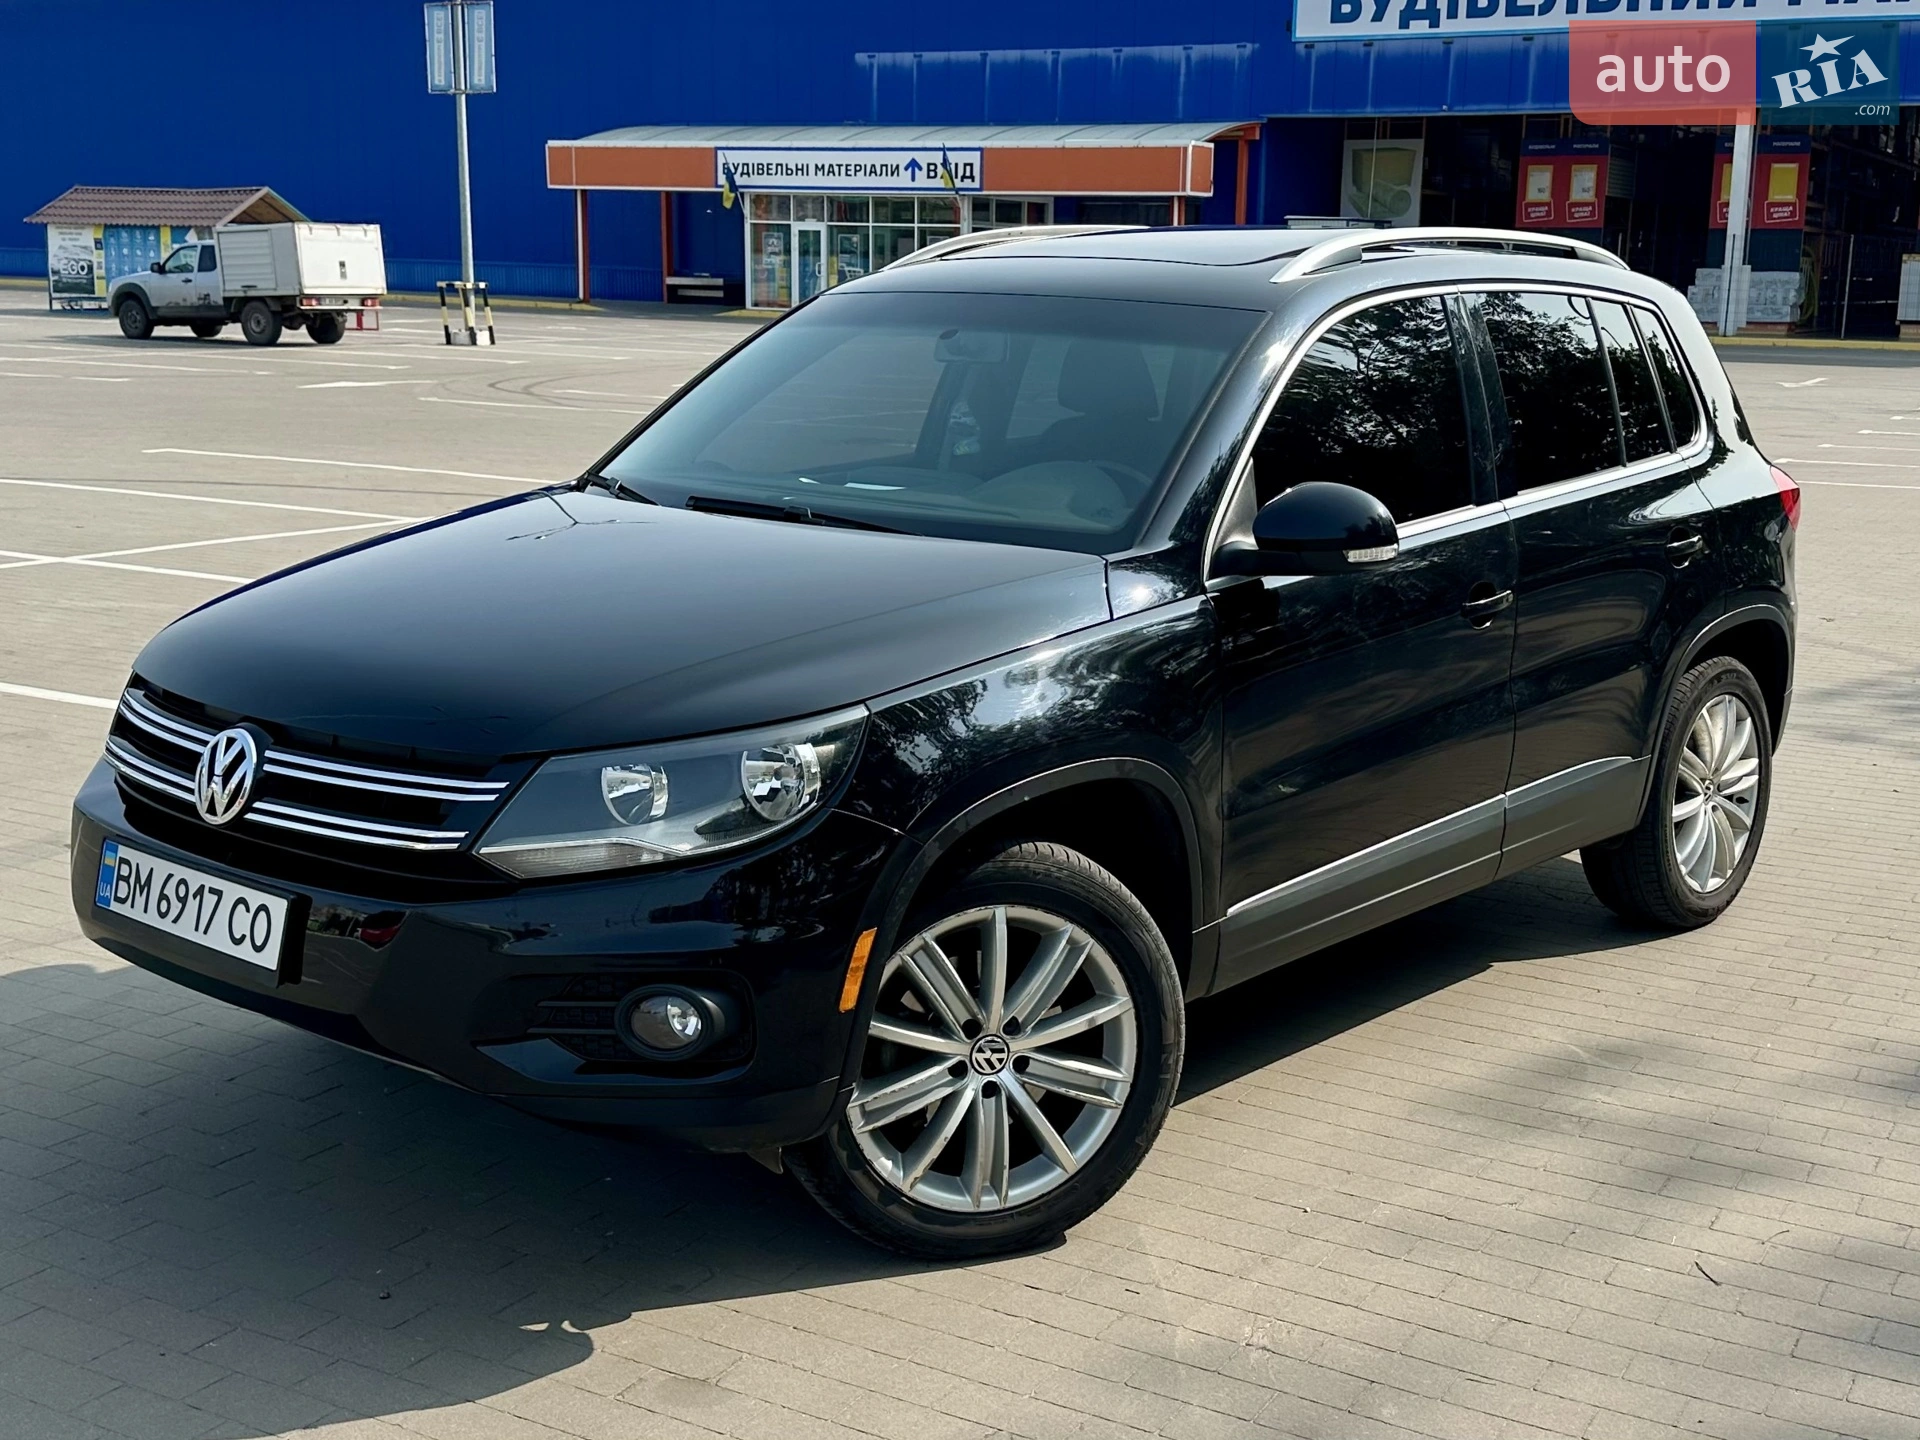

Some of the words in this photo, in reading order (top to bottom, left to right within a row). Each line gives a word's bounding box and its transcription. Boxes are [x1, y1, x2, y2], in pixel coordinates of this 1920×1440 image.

[722, 162, 810, 178] БУДІВЕЛЬНІ
[814, 163, 900, 177] МАТЕРІАЛИ
[59, 261, 88, 275] EGO
[100, 881, 111, 899] UA
[113, 856, 154, 914] BM
[156, 873, 224, 936] 6917
[228, 896, 272, 954] CO
